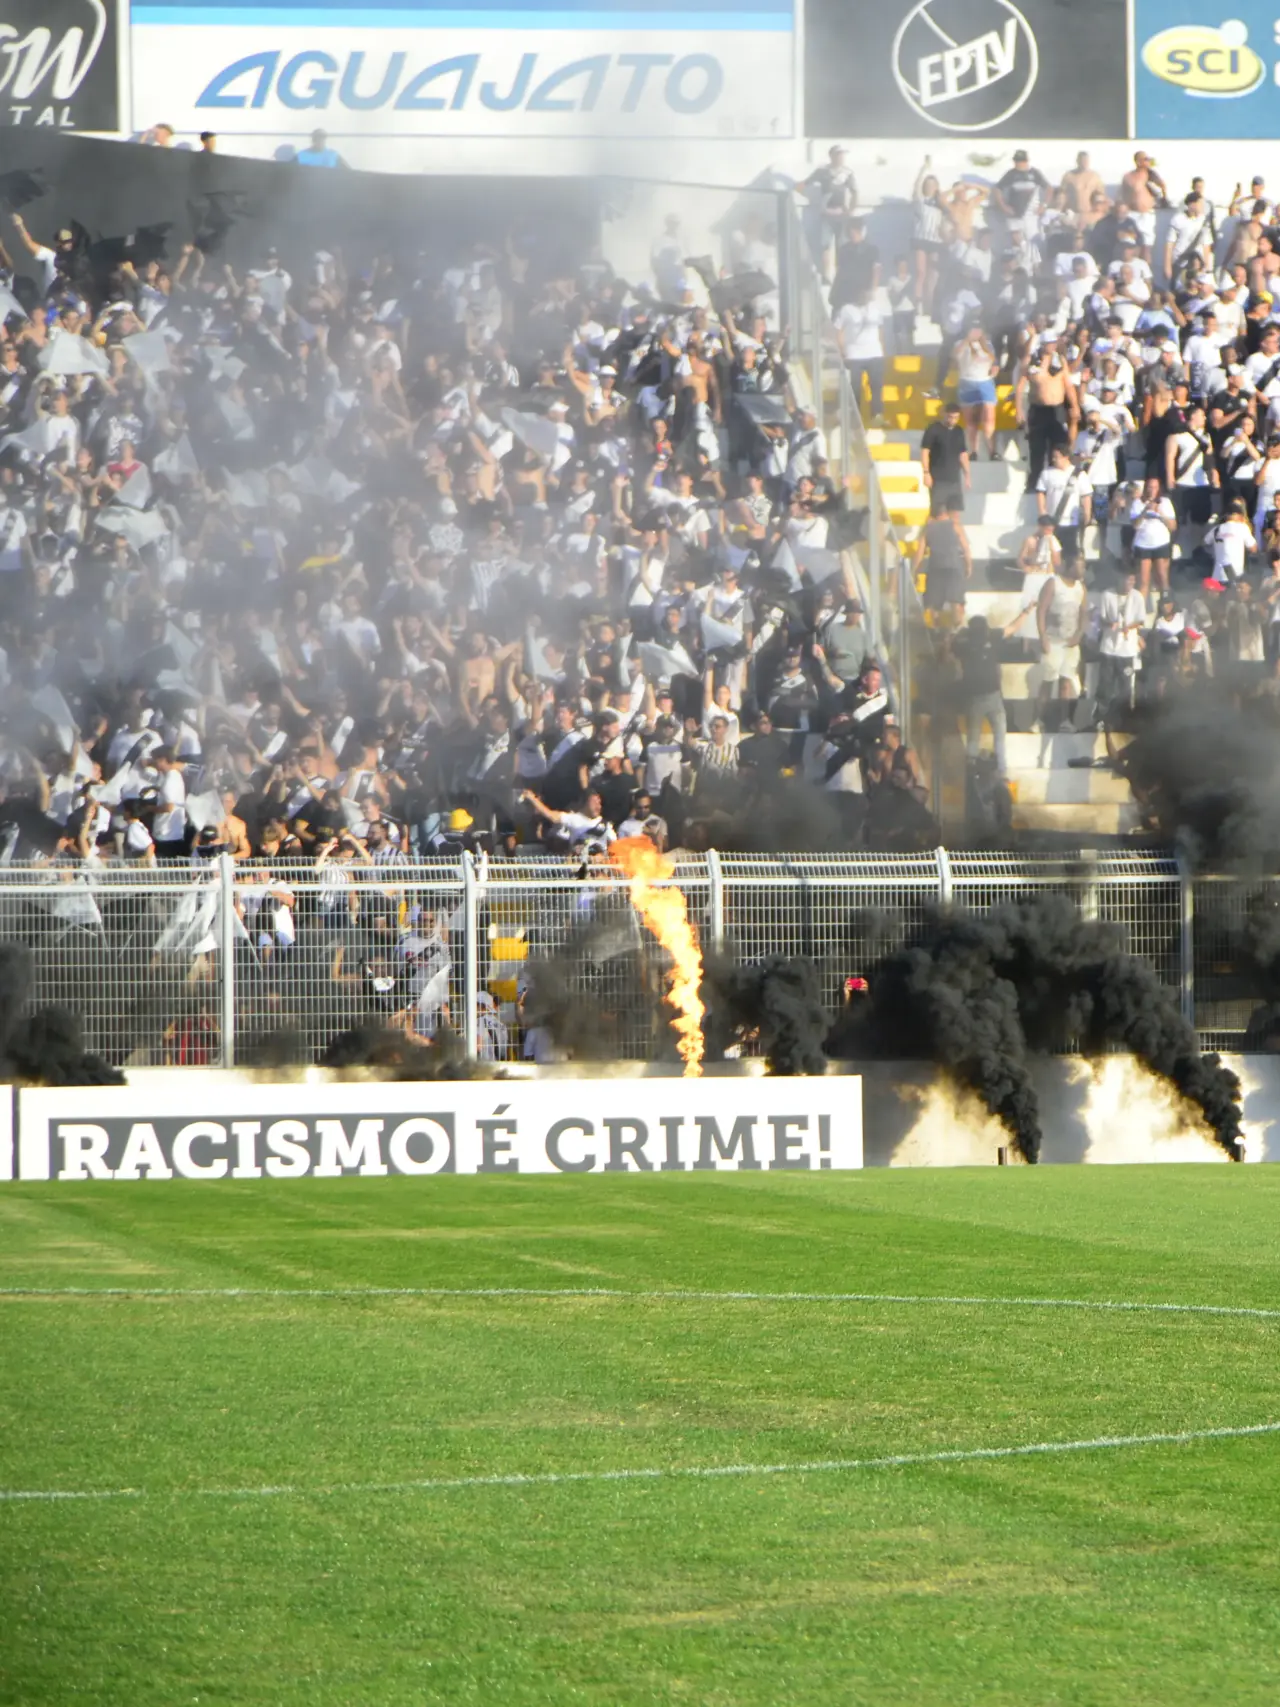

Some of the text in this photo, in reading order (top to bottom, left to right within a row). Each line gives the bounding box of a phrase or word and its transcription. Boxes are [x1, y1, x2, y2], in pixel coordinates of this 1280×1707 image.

[194, 50, 724, 114] AGUAJATO
[917, 17, 1017, 107] EPTV
[1165, 49, 1241, 75] SCI
[57, 1103, 832, 1180] RACISMO É CRIME!
